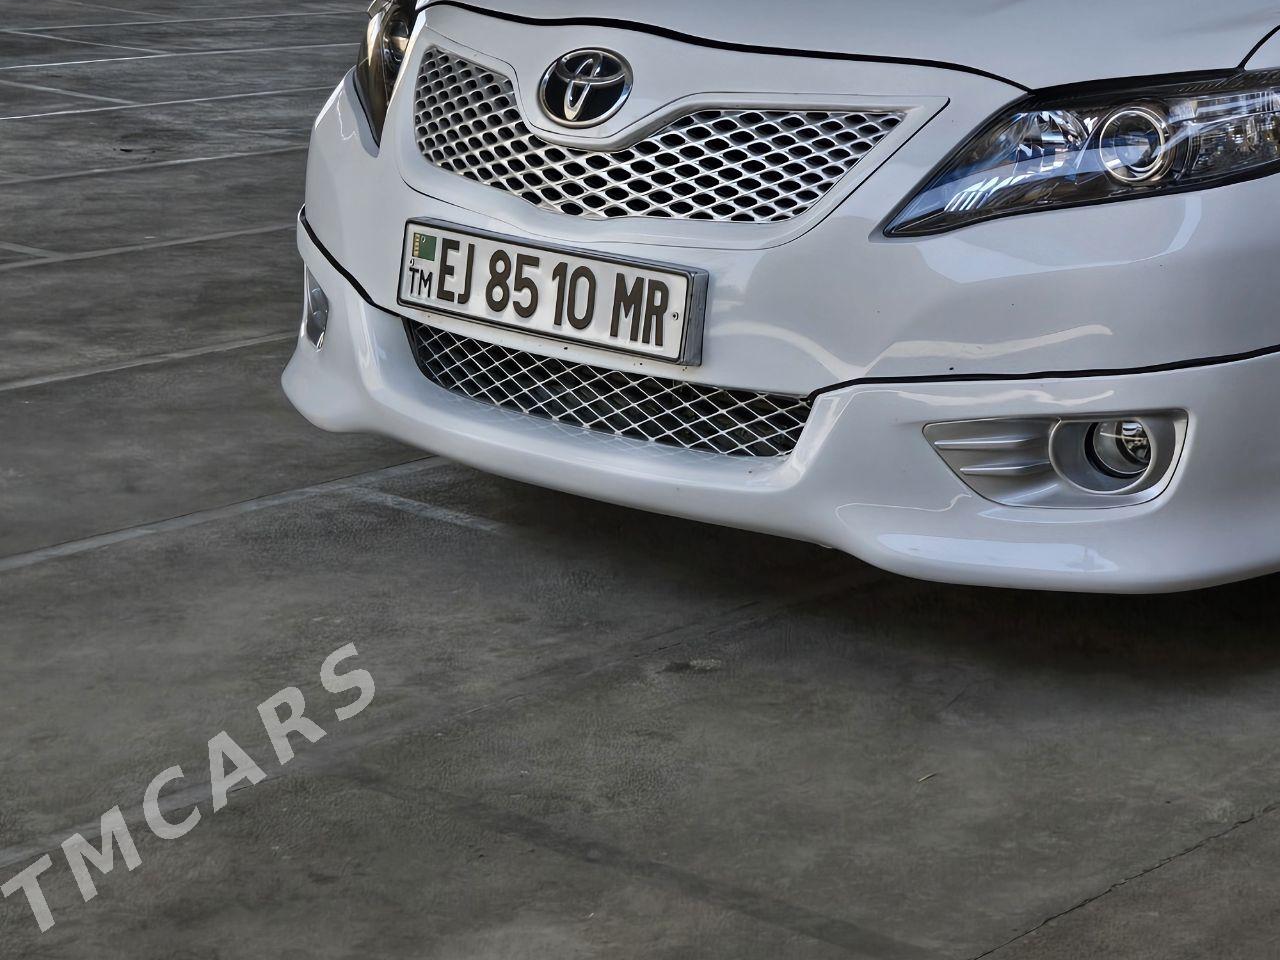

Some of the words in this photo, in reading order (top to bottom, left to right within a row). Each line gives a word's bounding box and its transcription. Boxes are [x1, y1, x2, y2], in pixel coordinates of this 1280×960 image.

[409, 267, 433, 298] TM
[436, 238, 475, 304] EJ
[485, 249, 596, 330] 8510
[610, 272, 669, 346] MR
